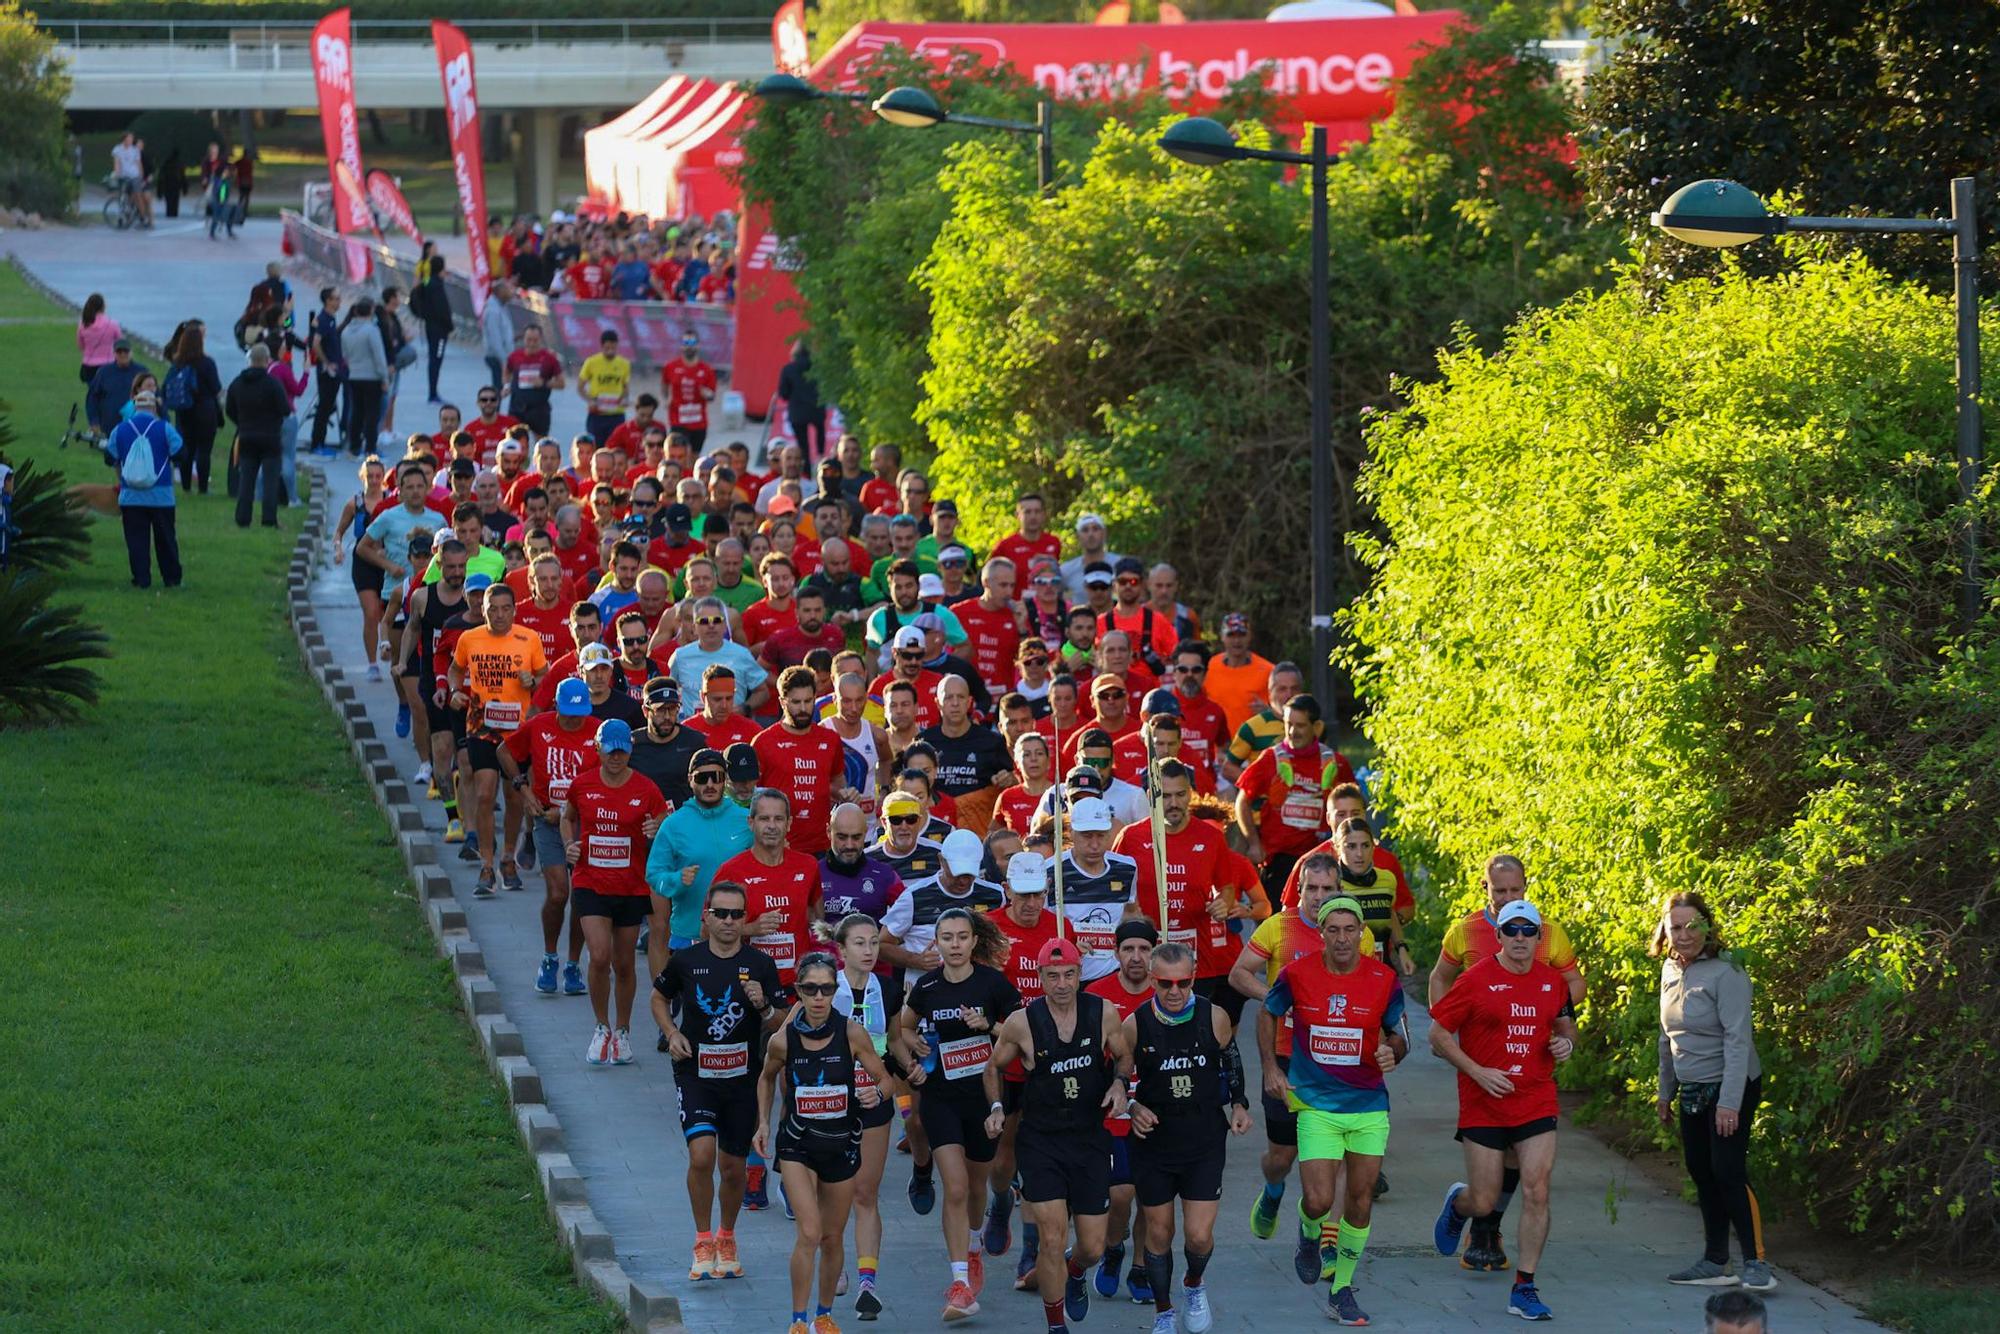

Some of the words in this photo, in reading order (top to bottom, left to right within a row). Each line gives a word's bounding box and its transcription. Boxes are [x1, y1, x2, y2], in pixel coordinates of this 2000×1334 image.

[1033, 63, 1143, 98] new
[1159, 49, 1393, 98] balance
[477, 662, 511, 670] BASKET
[478, 671, 518, 679] RUNNING
[480, 679, 503, 687] TEAM
[488, 711, 505, 719] LONG
[794, 757, 816, 769] Run
[793, 775, 817, 788] your
[794, 791, 815, 803] way.
[597, 807, 618, 820] Run
[595, 822, 618, 834] your
[592, 847, 611, 855] LONG
[611, 847, 627, 856] RUN
[765, 894, 789, 908] Run
[775, 946, 791, 957] RUN
[1019, 956, 1036, 970] Ru
[1511, 1003, 1536, 1017] Run
[1508, 1024, 1537, 1039] your
[1314, 1040, 1337, 1051] LONG
[1338, 1041, 1357, 1052] RUN
[1506, 1042, 1531, 1058] way.
[703, 1057, 726, 1067] LONG
[727, 1055, 744, 1065] RUN
[946, 1053, 970, 1066] LONG
[970, 1048, 989, 1061] RUN
[801, 1100, 824, 1110] LONG
[825, 1098, 843, 1110] RUN
